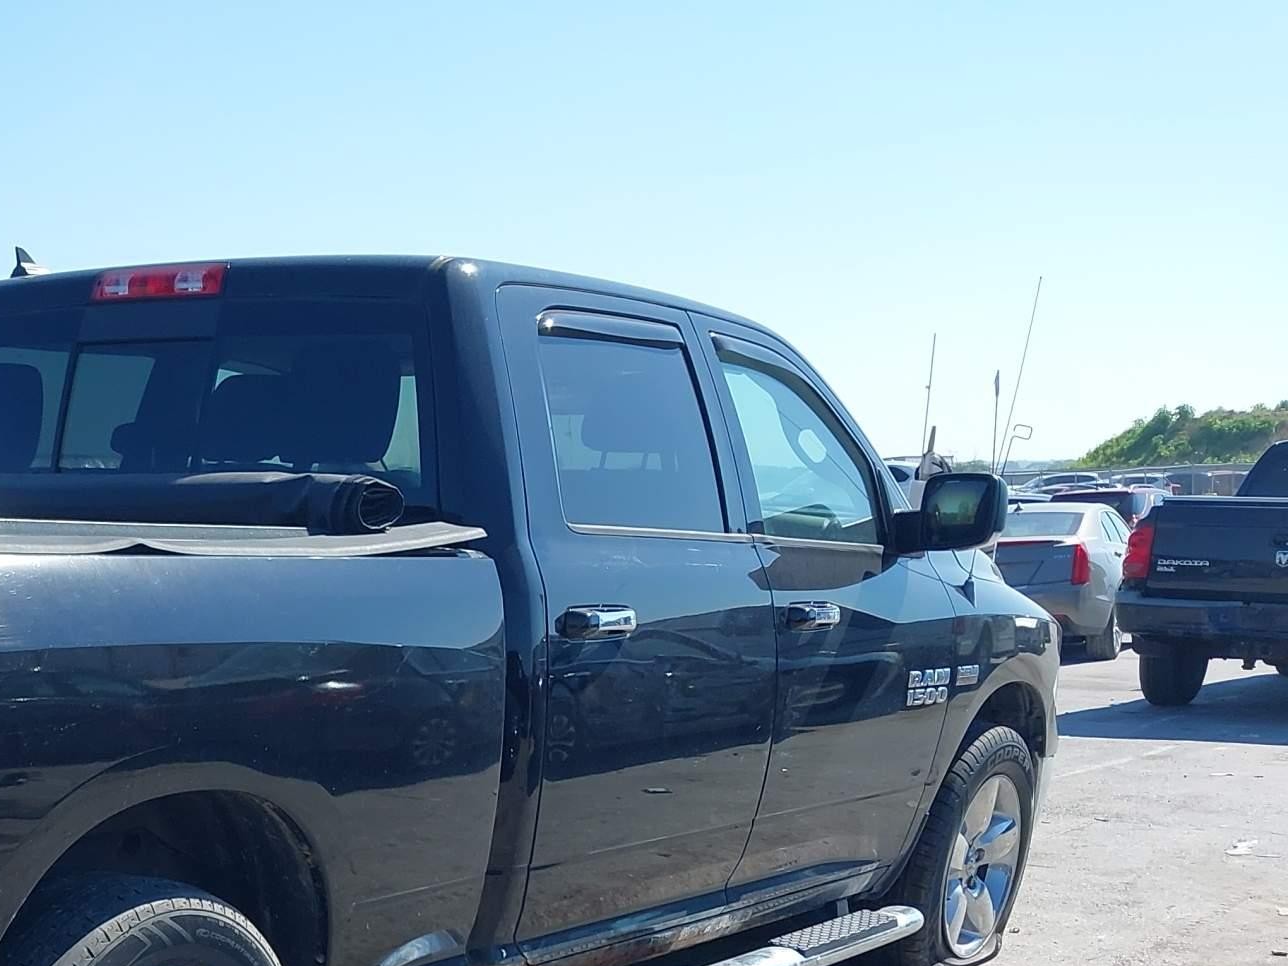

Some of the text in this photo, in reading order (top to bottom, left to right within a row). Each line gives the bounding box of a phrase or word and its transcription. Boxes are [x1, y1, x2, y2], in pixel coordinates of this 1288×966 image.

[1157, 558, 1210, 567] DAKOTA
[908, 667, 951, 688] RAM
[906, 687, 948, 707] 1500
